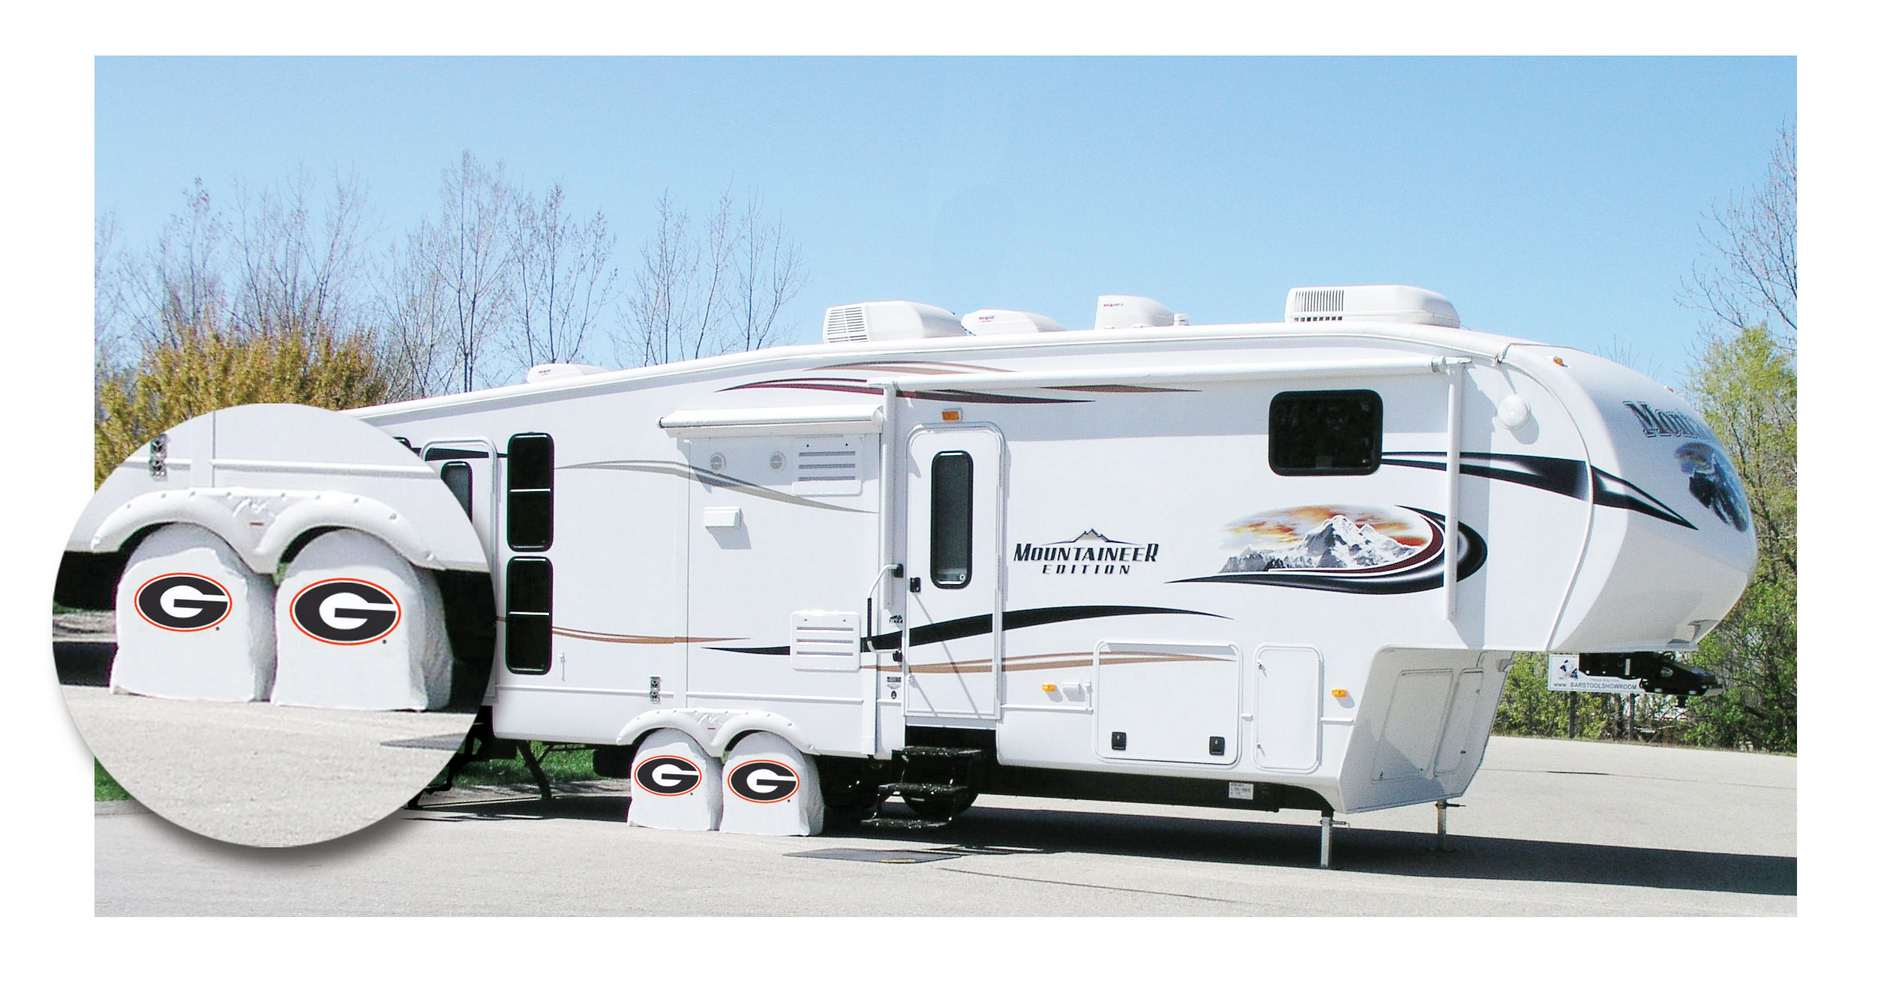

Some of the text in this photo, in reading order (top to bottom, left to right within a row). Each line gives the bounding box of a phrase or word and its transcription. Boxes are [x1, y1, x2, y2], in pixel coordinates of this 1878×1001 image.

[1013, 543, 1159, 562] MOUNTAINEER
[1042, 564, 1131, 575] EDITION
[138, 576, 229, 629] G
[294, 582, 397, 642] G
[637, 757, 699, 794] G
[730, 762, 797, 801] G
